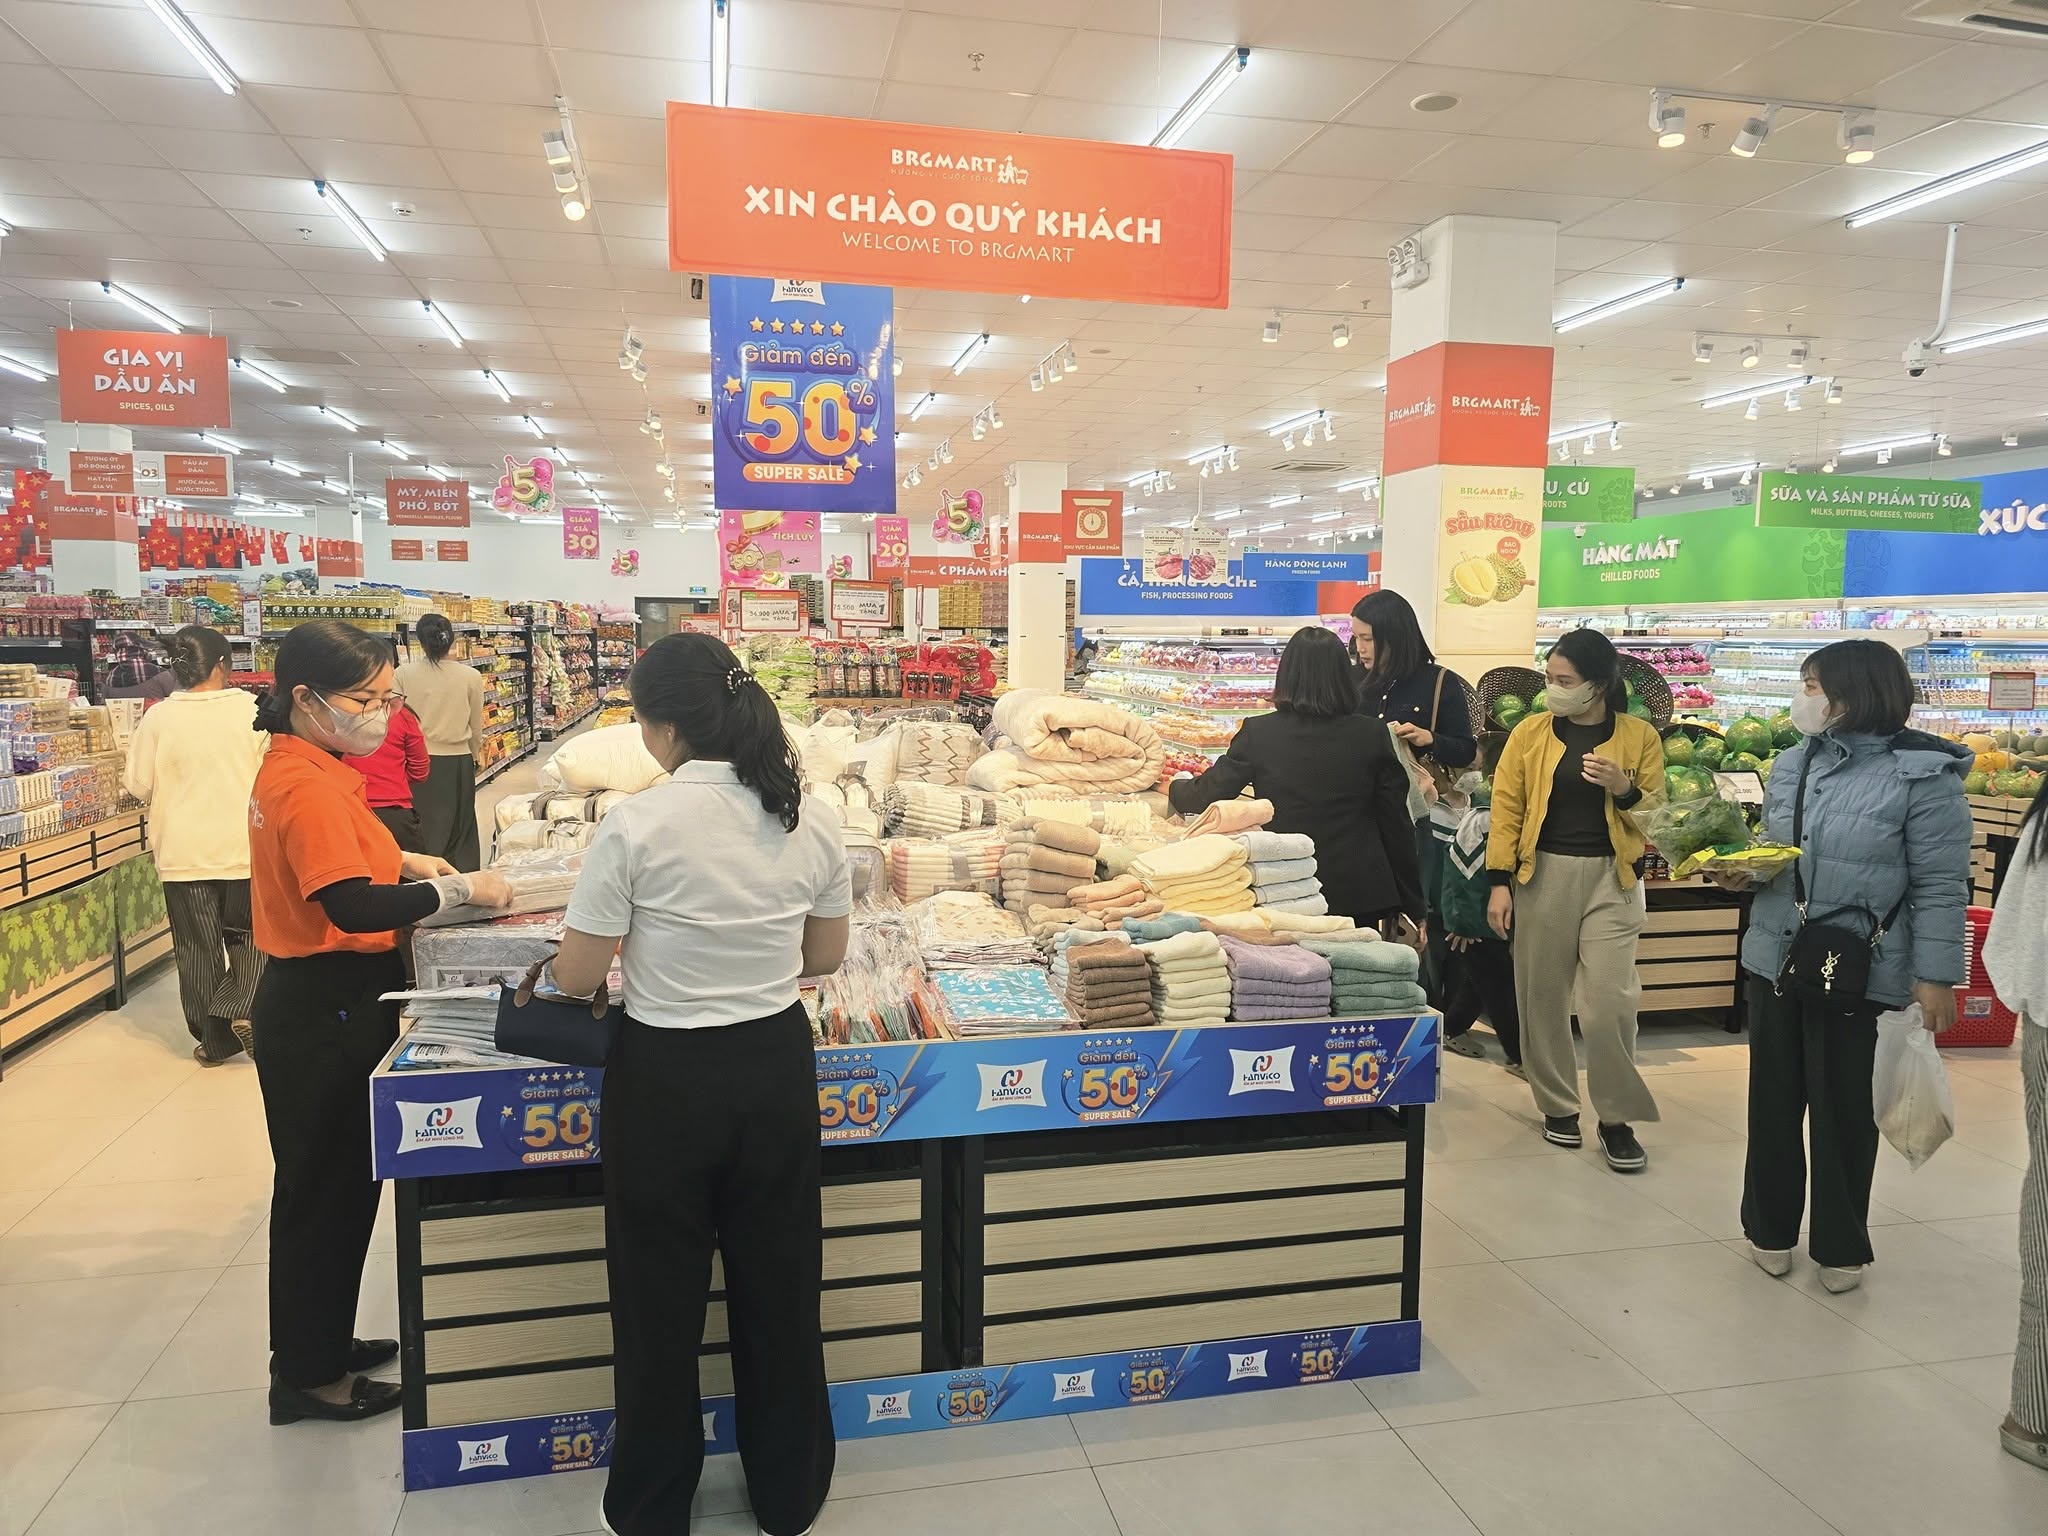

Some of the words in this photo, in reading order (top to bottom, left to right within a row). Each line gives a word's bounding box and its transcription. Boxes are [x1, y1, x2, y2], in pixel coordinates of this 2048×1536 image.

[891, 148, 997, 173] BRGMART
[744, 184, 815, 218] XIN
[827, 188, 936, 227] CHÀO
[945, 200, 1026, 234] QUÝ
[1037, 207, 1161, 244] KHÁCH
[843, 231, 940, 253] WELCOME
[946, 238, 974, 256] TO
[981, 242, 1075, 263] BRGMART
[103, 348, 150, 367] GIA
[155, 350, 183, 372] VỊ
[742, 342, 802, 366] Giảm
[809, 345, 852, 367] đến
[94, 367, 151, 393] DẦU
[157, 373, 196, 395] ĂN
[119, 402, 153, 412] SPICES,
[1389, 400, 1424, 422] BRGMART
[1452, 395, 1520, 409] BRGMART
[754, 466, 803, 480] SUPER
[807, 467, 844, 481] SALE
[1567, 478, 1590, 495] CỦ
[1770, 484, 1801, 502] SỮA
[1806, 486, 1828, 503] VÀ
[1832, 485, 1864, 504] SẢN
[1868, 487, 1916, 506] PHẨM
[1918, 490, 1940, 507] TỪ
[1942, 493, 1971, 509] SỮA
[433, 500, 459, 513] BỘT
[1811, 508, 1834, 517] MILKS,
[1836, 509, 1868, 518] BUTTERS,
[1870, 510, 1902, 520] CHEESES,
[1903, 511, 1935, 520] YOGURTS
[1446, 510, 1481, 535] Sầu
[1484, 513, 1535, 538] Riêng
[1978, 499, 2048, 536] XÚC
[772, 531, 794, 540] TÍCH
[1582, 541, 1633, 566] HÀNG
[1635, 535, 1681, 562] MÁT
[949, 561, 988, 576] PHẨM
[1265, 558, 1292, 568] HÀNG
[1322, 560, 1347, 569] LẠNH
[1117, 571, 1144, 588] CÁ,
[1600, 570, 1633, 582] CHILLED
[1633, 568, 1660, 580] FOODS
[1141, 592, 1161, 601] FISH,
[1162, 592, 1208, 600] PROCESSING
[1329, 1095, 1352, 1105] SUPER
[1354, 1094, 1371, 1102] SALE
[1084, 1112, 1110, 1120] SUPER
[1112, 1110, 1131, 1118] SALE
[821, 1130, 848, 1140] SUPER
[850, 1128, 871, 1137] SALE
[528, 1152, 559, 1162] SUPER
[562, 1150, 584, 1159] SALE
